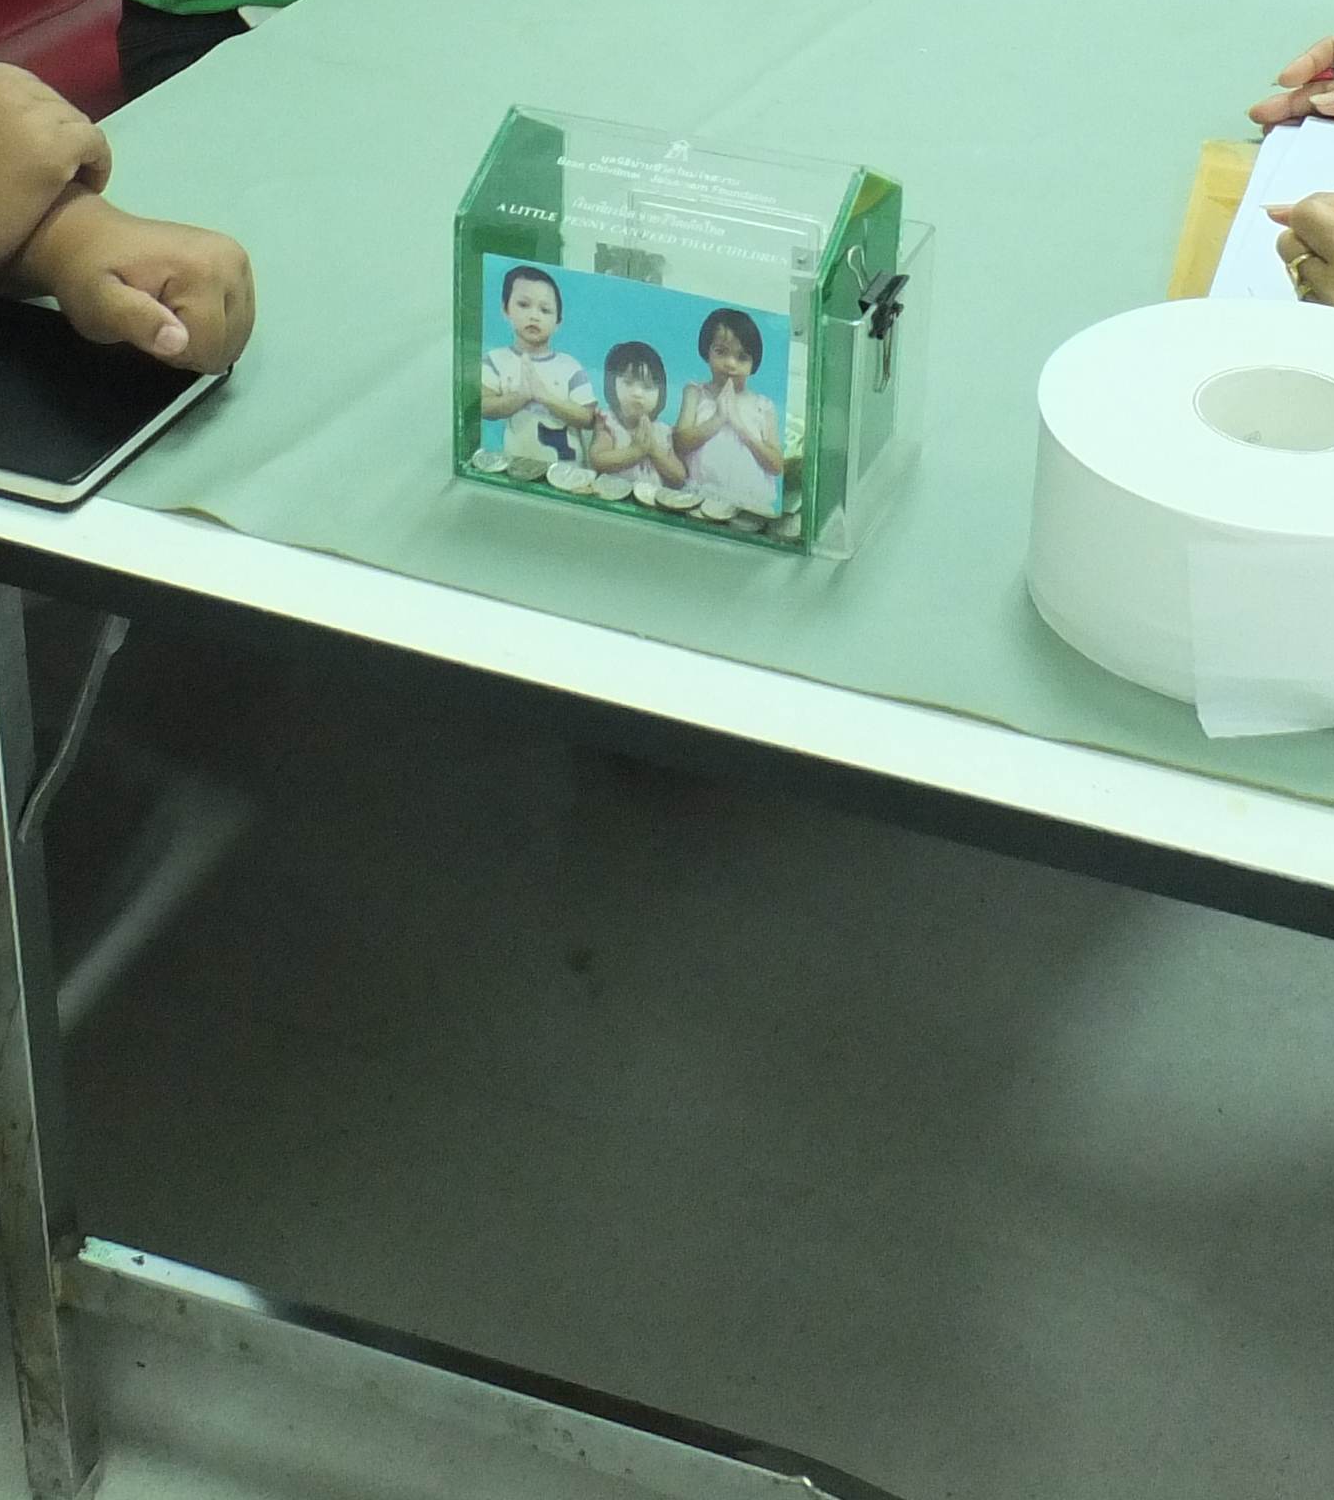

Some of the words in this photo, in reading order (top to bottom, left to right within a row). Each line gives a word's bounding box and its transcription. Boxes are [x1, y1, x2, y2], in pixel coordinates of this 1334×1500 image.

[711, 185, 777, 205] Foundation
[496, 202, 506, 213] A
[506, 203, 559, 222] LITTLE
[563, 213, 608, 232] PENNY
[610, 221, 640, 239] CAN
[641, 230, 677, 246] FEED
[681, 236, 715, 252] THAI
[716, 243, 789, 266] CHILDREN
